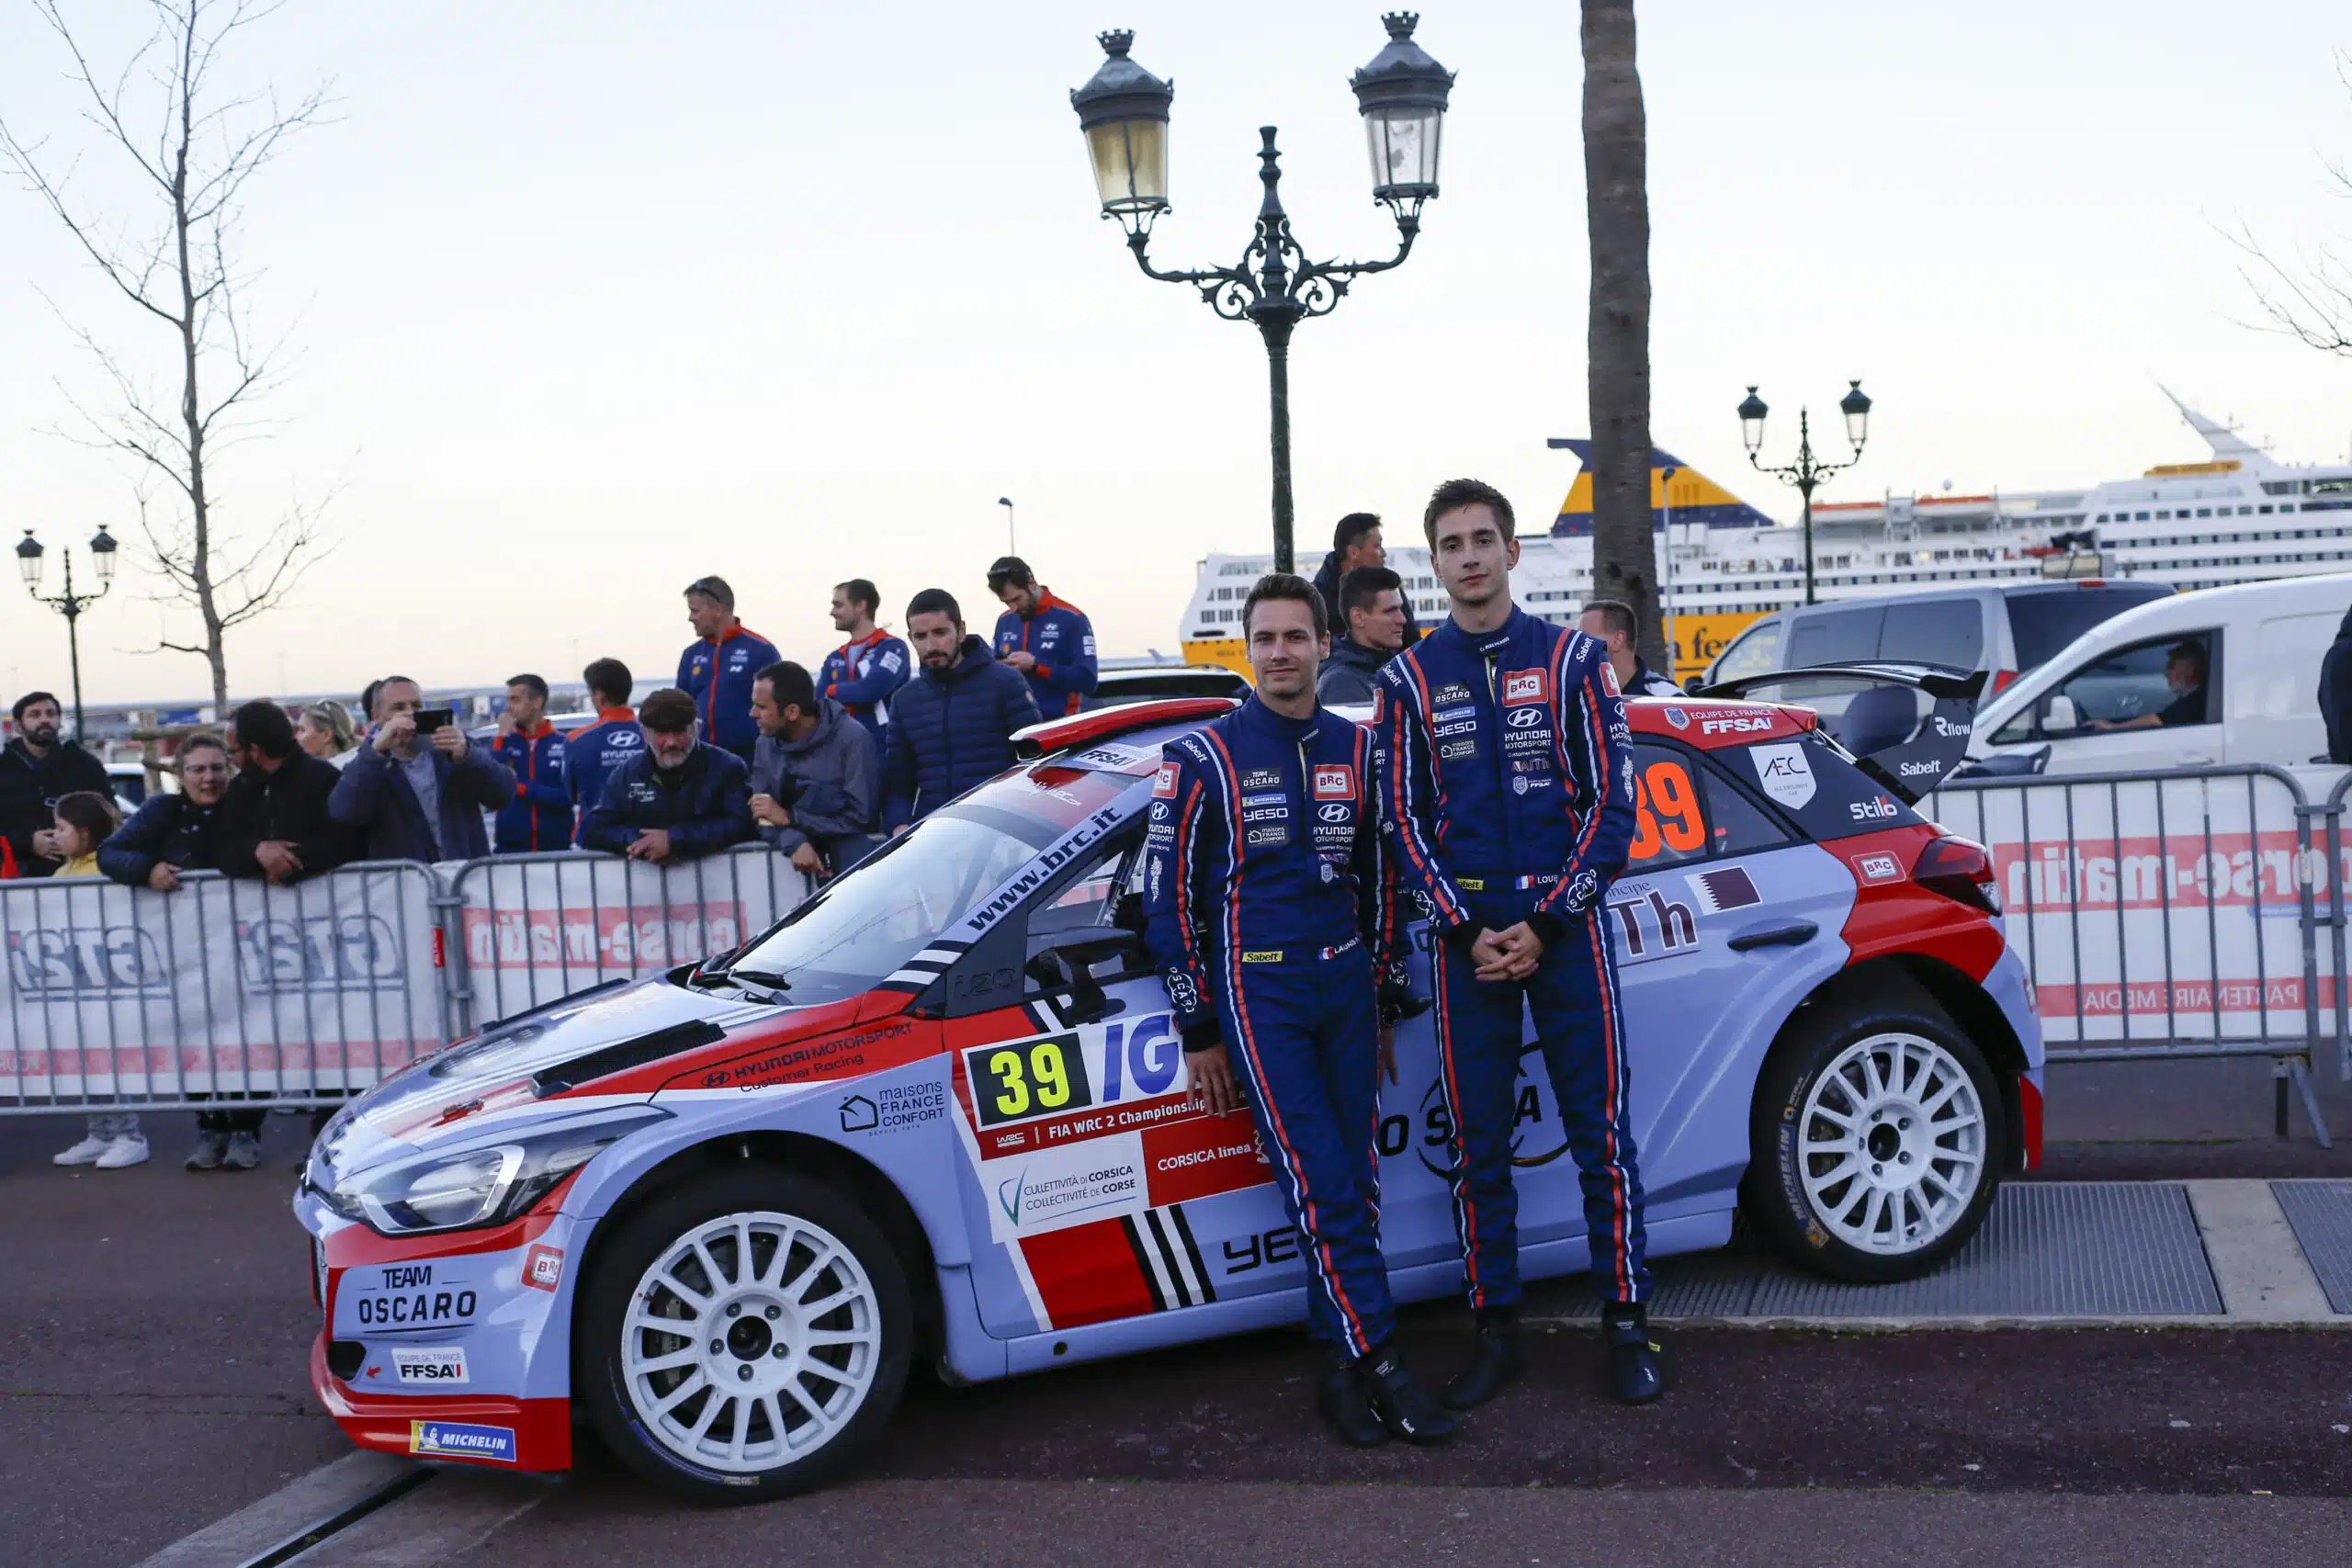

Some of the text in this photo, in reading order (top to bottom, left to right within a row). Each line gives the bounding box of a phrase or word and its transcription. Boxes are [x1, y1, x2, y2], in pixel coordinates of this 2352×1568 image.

[1576, 637, 1594, 662] Sabelt
[1383, 665, 1402, 687] Sabelt
[1510, 680, 1536, 693] BRC
[1435, 691, 1470, 703] OSCARO
[1690, 708, 1775, 720] EQUIPE DE FRANCE
[1433, 720, 1476, 738] YESO
[1702, 717, 1766, 735] FFSA
[1504, 729, 1552, 742] HYUNDAI
[1505, 739, 1552, 750] MOTORSPORT
[1182, 739, 1207, 763] Sabelt
[1900, 760, 1941, 776] Sabelt
[1157, 771, 1170, 784] RC
[1243, 776, 1280, 787] OSCARO
[1319, 775, 1343, 786] BRC
[1243, 807, 1288, 822] YESO
[1849, 796, 1898, 819] Stilo
[1148, 824, 1174, 834] YUNDAI
[1313, 826, 1356, 835] HYUNDAI
[967, 807, 1123, 931] www.brc.it
[1866, 860, 1892, 873] BRC
[1459, 879, 1480, 889] belt
[1607, 888, 1699, 957] Th
[1246, 953, 1280, 962] Sabelt
[735, 1021, 913, 1079] HYUNDAI MOTORSPORT
[740, 1055, 865, 1092] Customer Racing
[989, 1043, 1070, 1115] 39
[879, 1081, 943, 1101] maisons
[880, 1094, 944, 1113] FRANCE
[882, 1107, 945, 1127] CONFORT
[1048, 1122, 1070, 1139] FIA
[1073, 1116, 1103, 1133] WRC
[1106, 1114, 1115, 1128] 2
[997, 1132, 1025, 1143] WRC
[1158, 1142, 1251, 1171] CORSICA linea
[1023, 1165, 1134, 1196] CULLETTIVITÀ DI CORSICA
[1779, 1129, 1805, 1221] MICHELIN
[1025, 1178, 1136, 1211] COLLECTIVITÉ DE CORSE
[382, 1266, 431, 1289] TEAM
[358, 1290, 476, 1324] OSCARO
[433, 1352, 462, 1362] FRANCE
[401, 1363, 455, 1379] FFSA
[442, 1433, 506, 1450] MICHELIN
